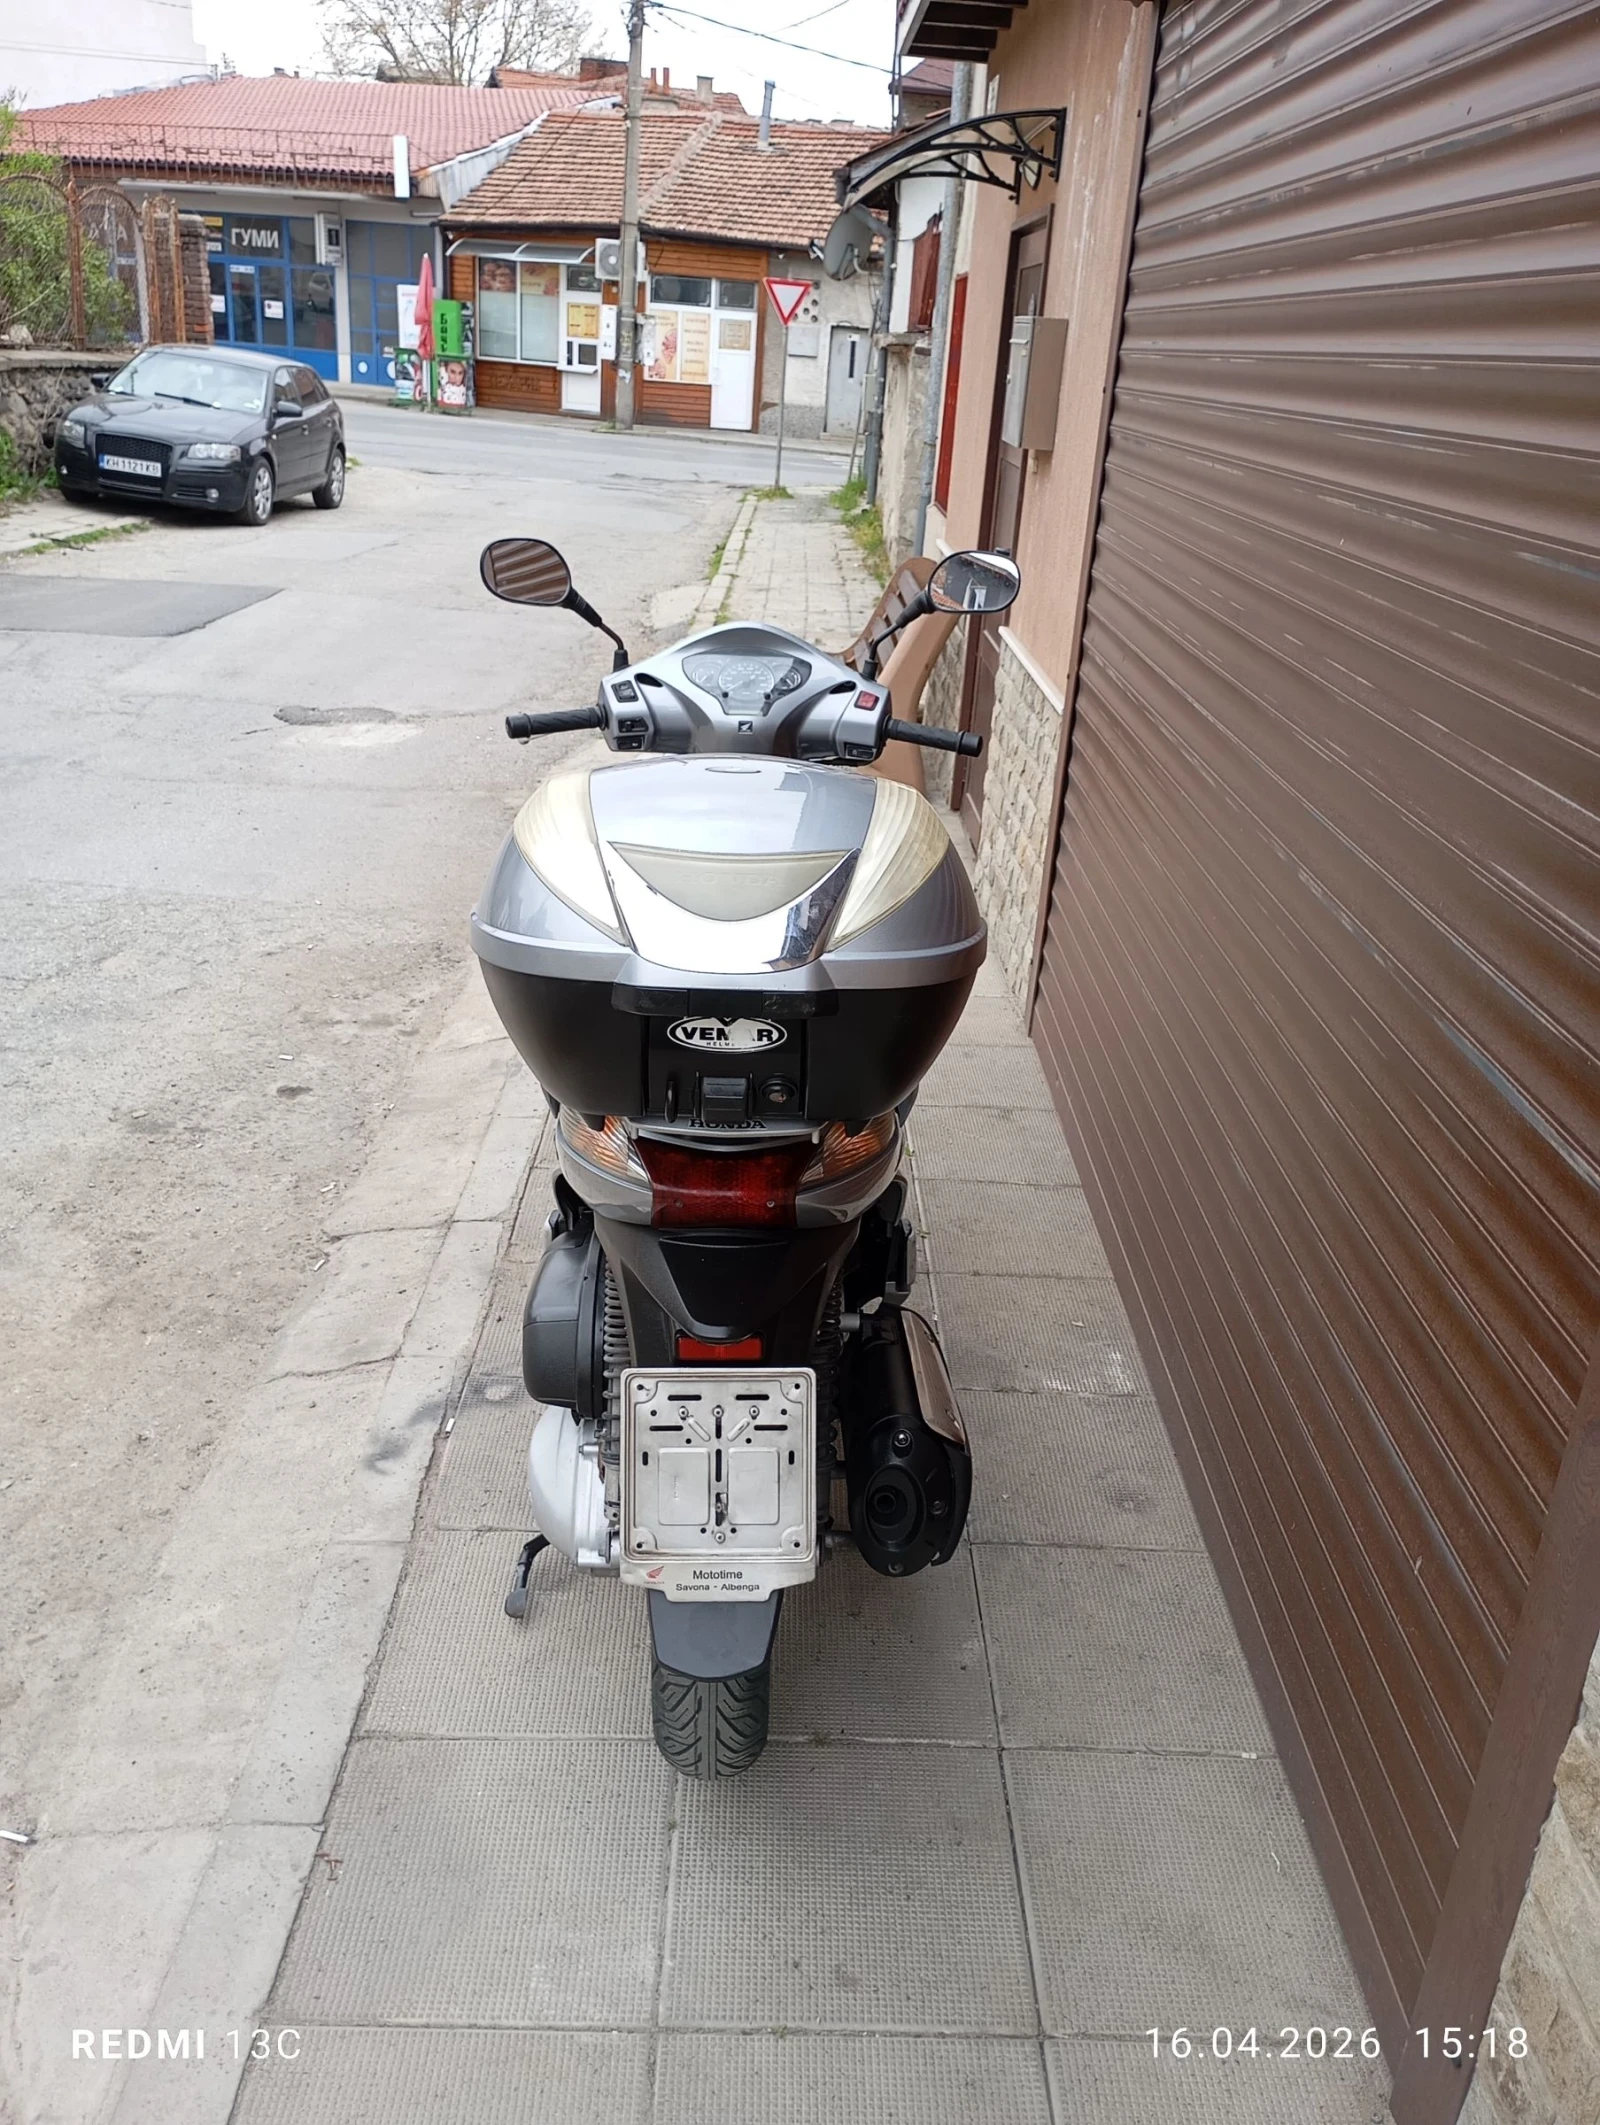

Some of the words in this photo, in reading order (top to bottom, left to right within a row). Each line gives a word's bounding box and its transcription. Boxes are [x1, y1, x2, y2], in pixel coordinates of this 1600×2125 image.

[230, 227, 279, 249] ГУМИ
[680, 1026, 775, 1043] VEMR
[692, 1570, 744, 1580] Mototime
[675, 1583, 711, 1592] Savona
[720, 1583, 760, 1593] Albenga
